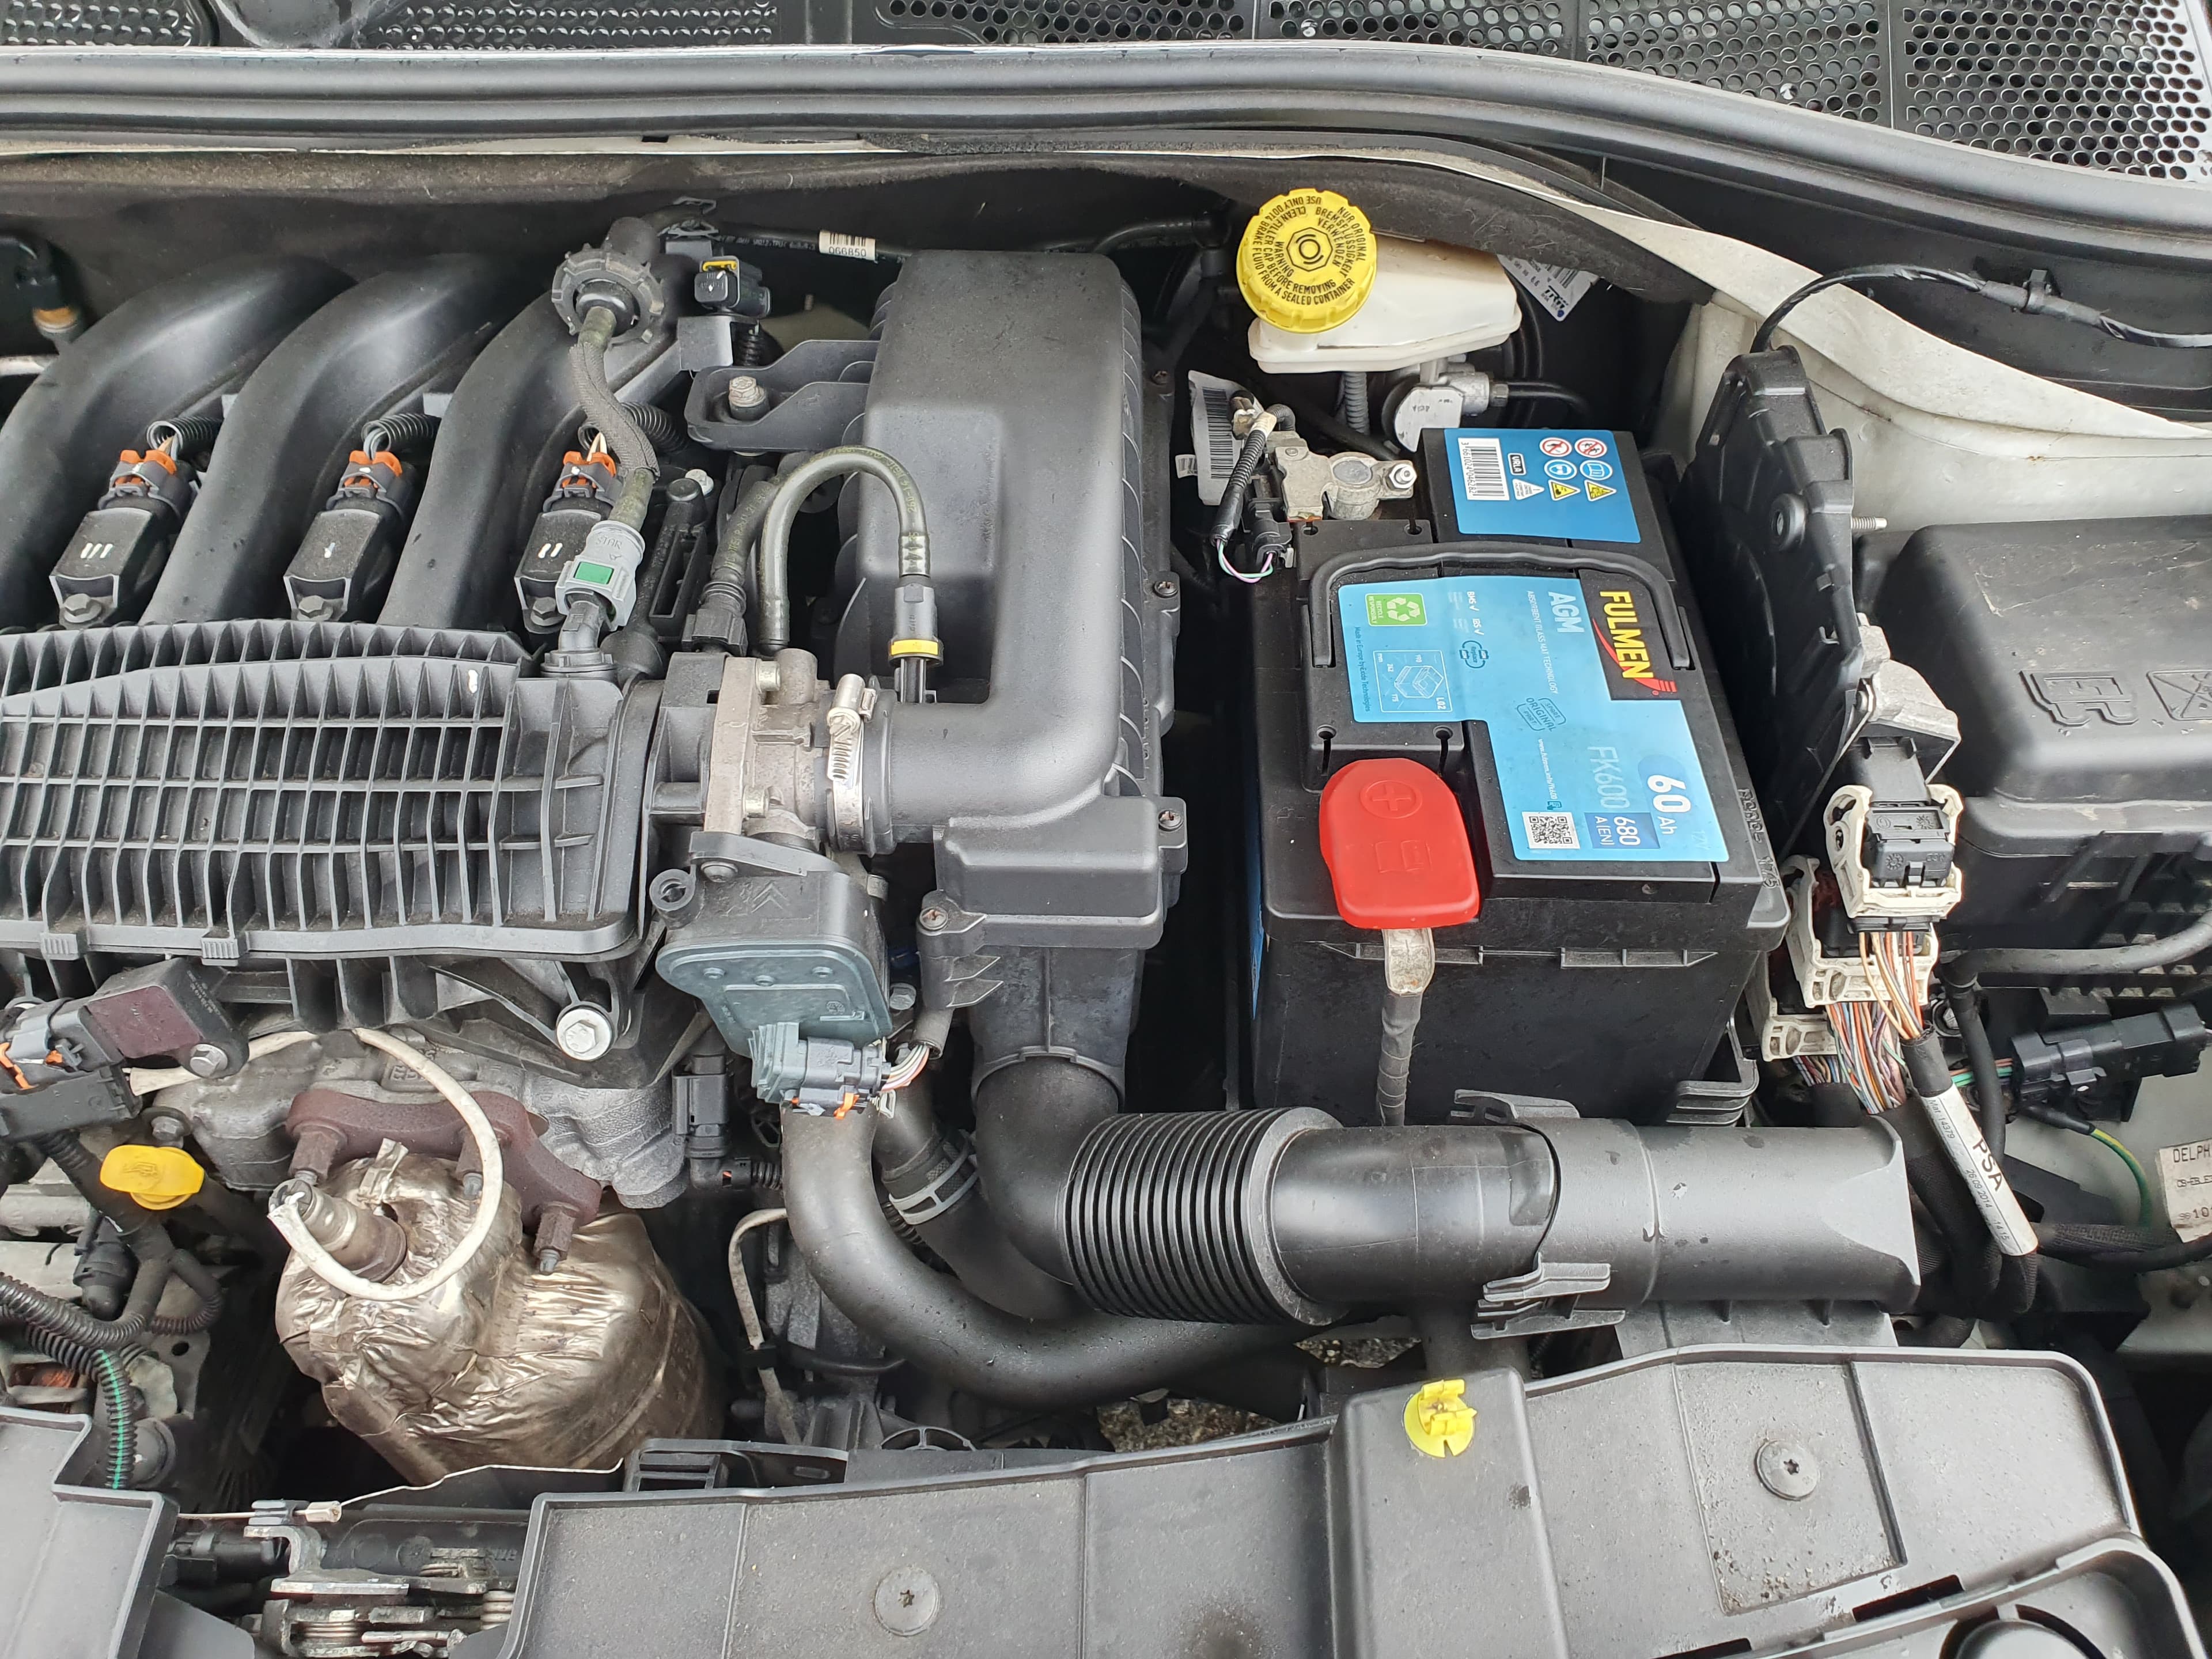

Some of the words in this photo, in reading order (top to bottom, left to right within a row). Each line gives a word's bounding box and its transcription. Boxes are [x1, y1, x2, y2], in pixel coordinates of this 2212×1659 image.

[1284, 196, 1304, 209] ONLY
[1306, 196, 1321, 204] USE
[1264, 206, 1283, 221] DOT4
[1282, 206, 1306, 221] CLEAN
[1252, 221, 1269, 245] BRAKE
[1263, 219, 1283, 245] FILLER
[1317, 217, 1346, 268] VERWENDEN
[1337, 206, 1355, 223] NUR
[1351, 223, 1367, 262] ORIGINAL
[1252, 247, 1265, 271] FLUID
[1263, 247, 1274, 263] CAP
[1274, 241, 1294, 278] WARNING
[1257, 268, 1278, 291] FROM
[1267, 262, 1294, 290] BEFORE
[1293, 279, 1336, 294] REMOVING
[1274, 287, 1282, 297] A
[1281, 290, 1312, 305] SEALED
[1313, 278, 1355, 305] CONTAINER
[1510, 455, 1522, 473] VRLA
[1548, 592, 1585, 633] AGM
[1527, 590, 1541, 623] ABSORBENT
[1543, 656, 1558, 694] TECHNOLOGY
[1599, 590, 1654, 679] FULMEN
[1525, 697, 1556, 732] ORIGINAL
[1587, 746, 1631, 809] FK600
[1647, 775, 1691, 813] 60
[1613, 816, 1641, 846] 680
[1656, 816, 1677, 835] Ah
[1972, 1138, 2002, 1192] PSA
